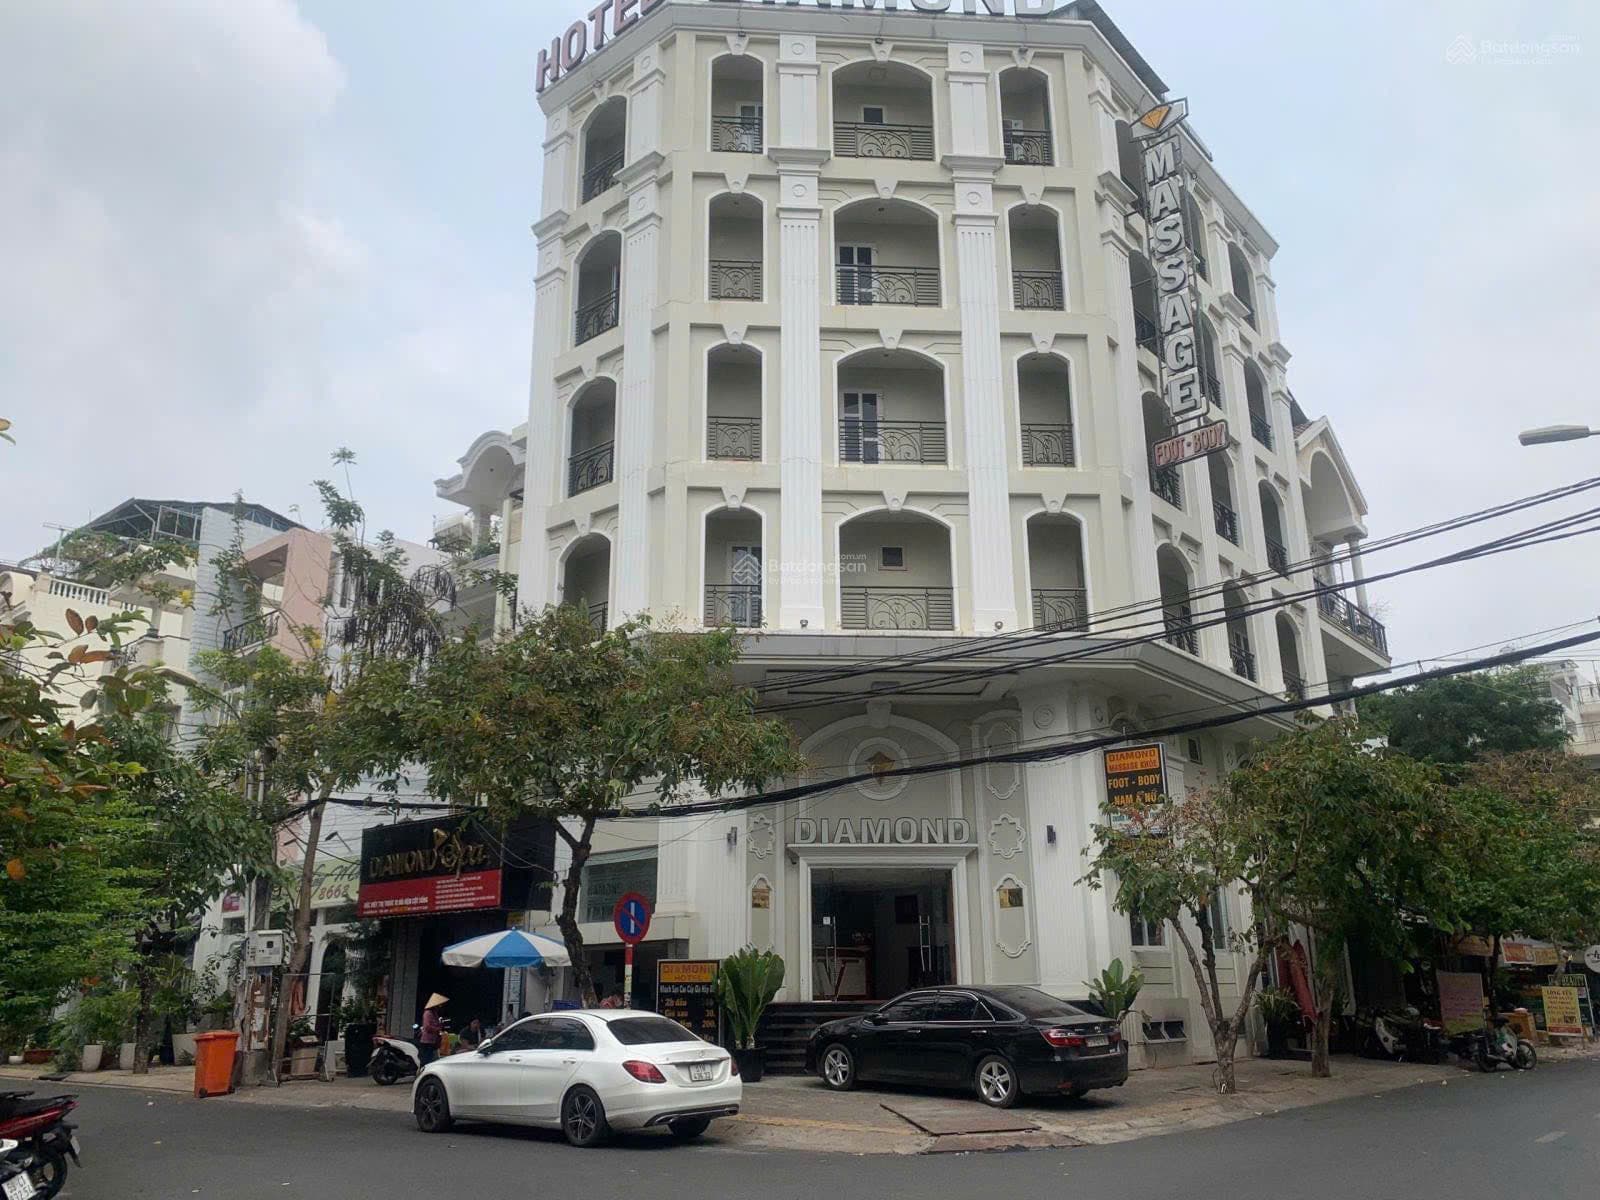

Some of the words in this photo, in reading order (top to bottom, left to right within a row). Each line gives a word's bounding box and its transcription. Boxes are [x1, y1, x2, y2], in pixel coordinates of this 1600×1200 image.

[1145, 142, 1199, 416] MASSAGE
[1109, 749, 1156, 762] DIAMOND
[1108, 777, 1130, 790] FOOT
[1137, 773, 1161, 787] BODY
[1114, 793, 1134, 806] NAM
[794, 816, 971, 845] DIAMOND
[369, 849, 438, 878] DIAMOND
